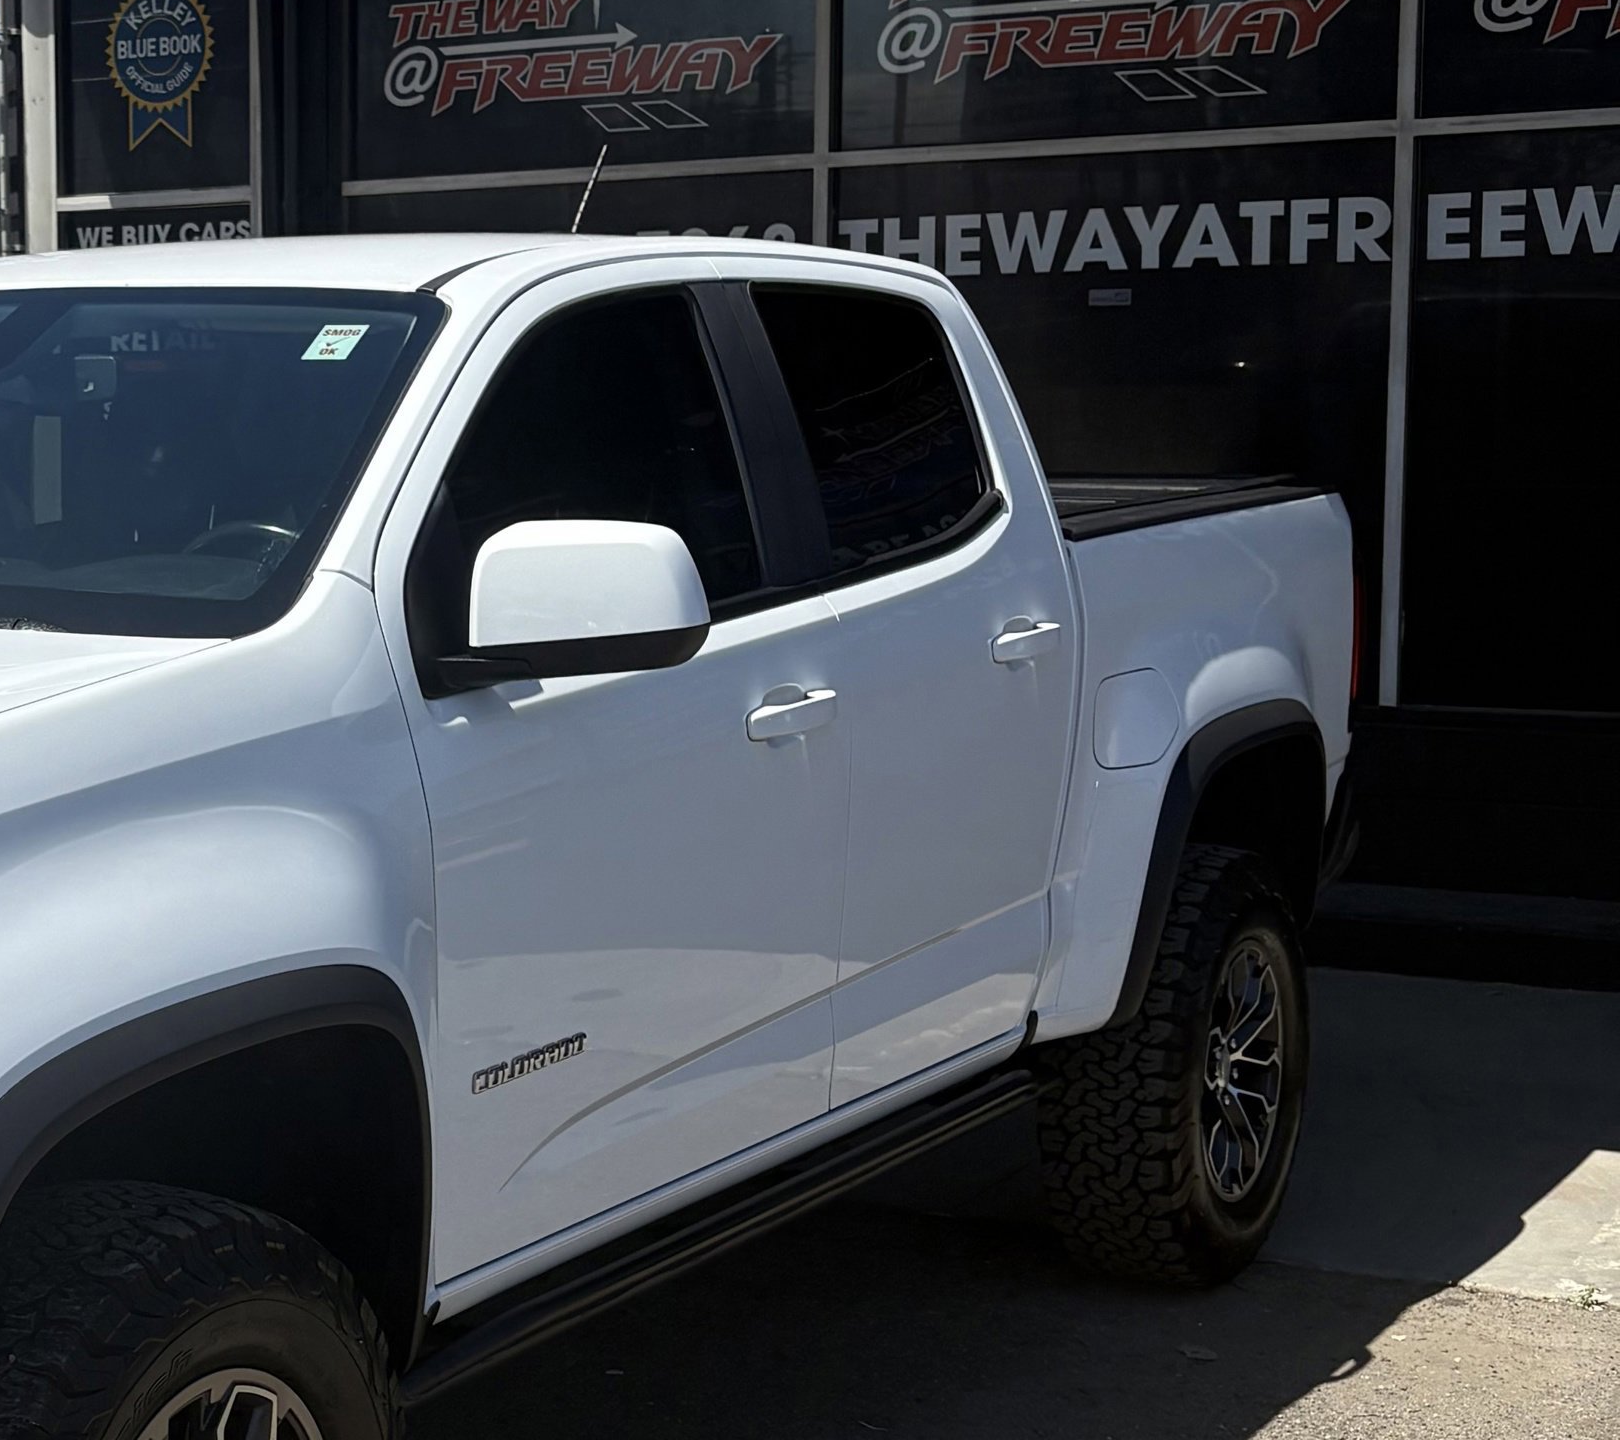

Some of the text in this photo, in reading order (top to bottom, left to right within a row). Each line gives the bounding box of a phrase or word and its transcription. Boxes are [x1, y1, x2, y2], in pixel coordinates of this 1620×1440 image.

[117, 34, 202, 59] BLUE BOOK
[125, 62, 194, 94] OFFICIAL GUIDE
[76, 220, 251, 249] WE BUY CARS
[322, 328, 362, 337] SMOG
[318, 347, 340, 356] OK
[472, 1031, 588, 1095] COLORADO
